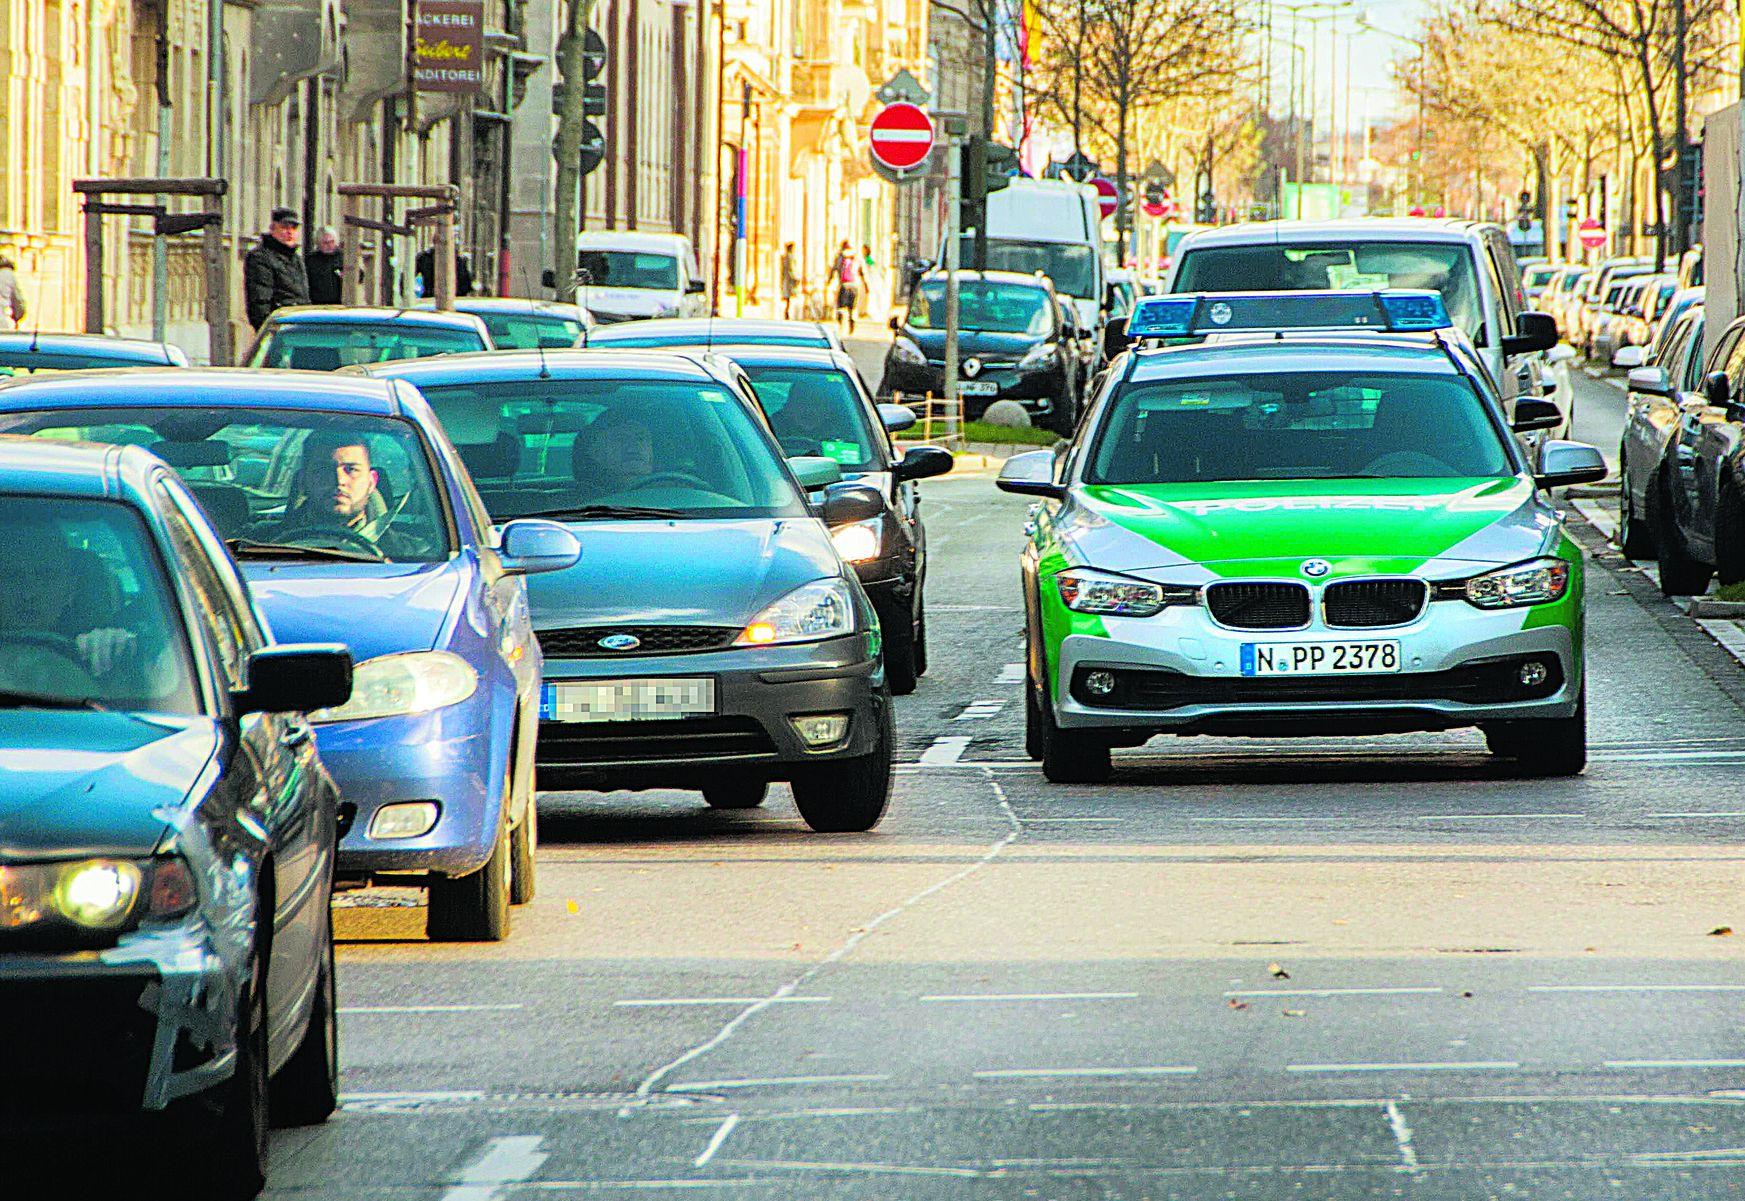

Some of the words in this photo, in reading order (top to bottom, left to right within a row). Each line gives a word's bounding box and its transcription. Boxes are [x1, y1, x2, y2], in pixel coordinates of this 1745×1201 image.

[1183, 499, 1425, 516] POLIZEI
[1258, 647, 1273, 671] N
[1293, 646, 1325, 670] PP
[1332, 643, 1396, 670] 2378
